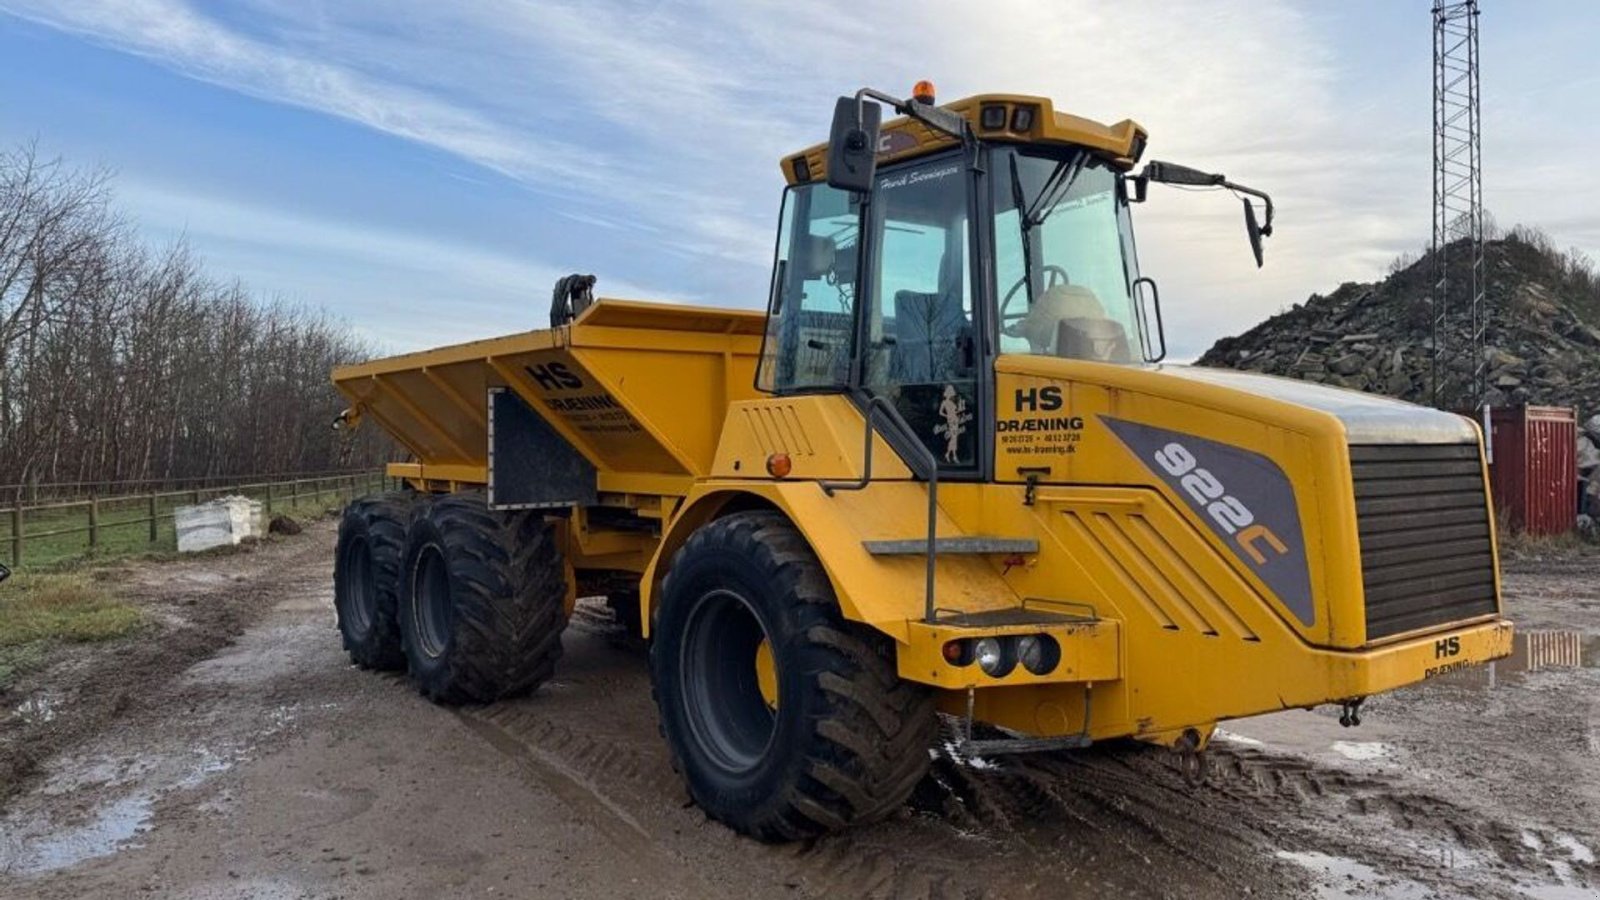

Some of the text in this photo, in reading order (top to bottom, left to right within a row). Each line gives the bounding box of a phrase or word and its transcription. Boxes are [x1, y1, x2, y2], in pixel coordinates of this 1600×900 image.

[525, 362, 583, 390] HS
[1015, 386, 1063, 412] HS
[996, 417, 1084, 432] DRÆNING
[1154, 442, 1289, 566] 922C
[1435, 635, 1461, 660] HS
